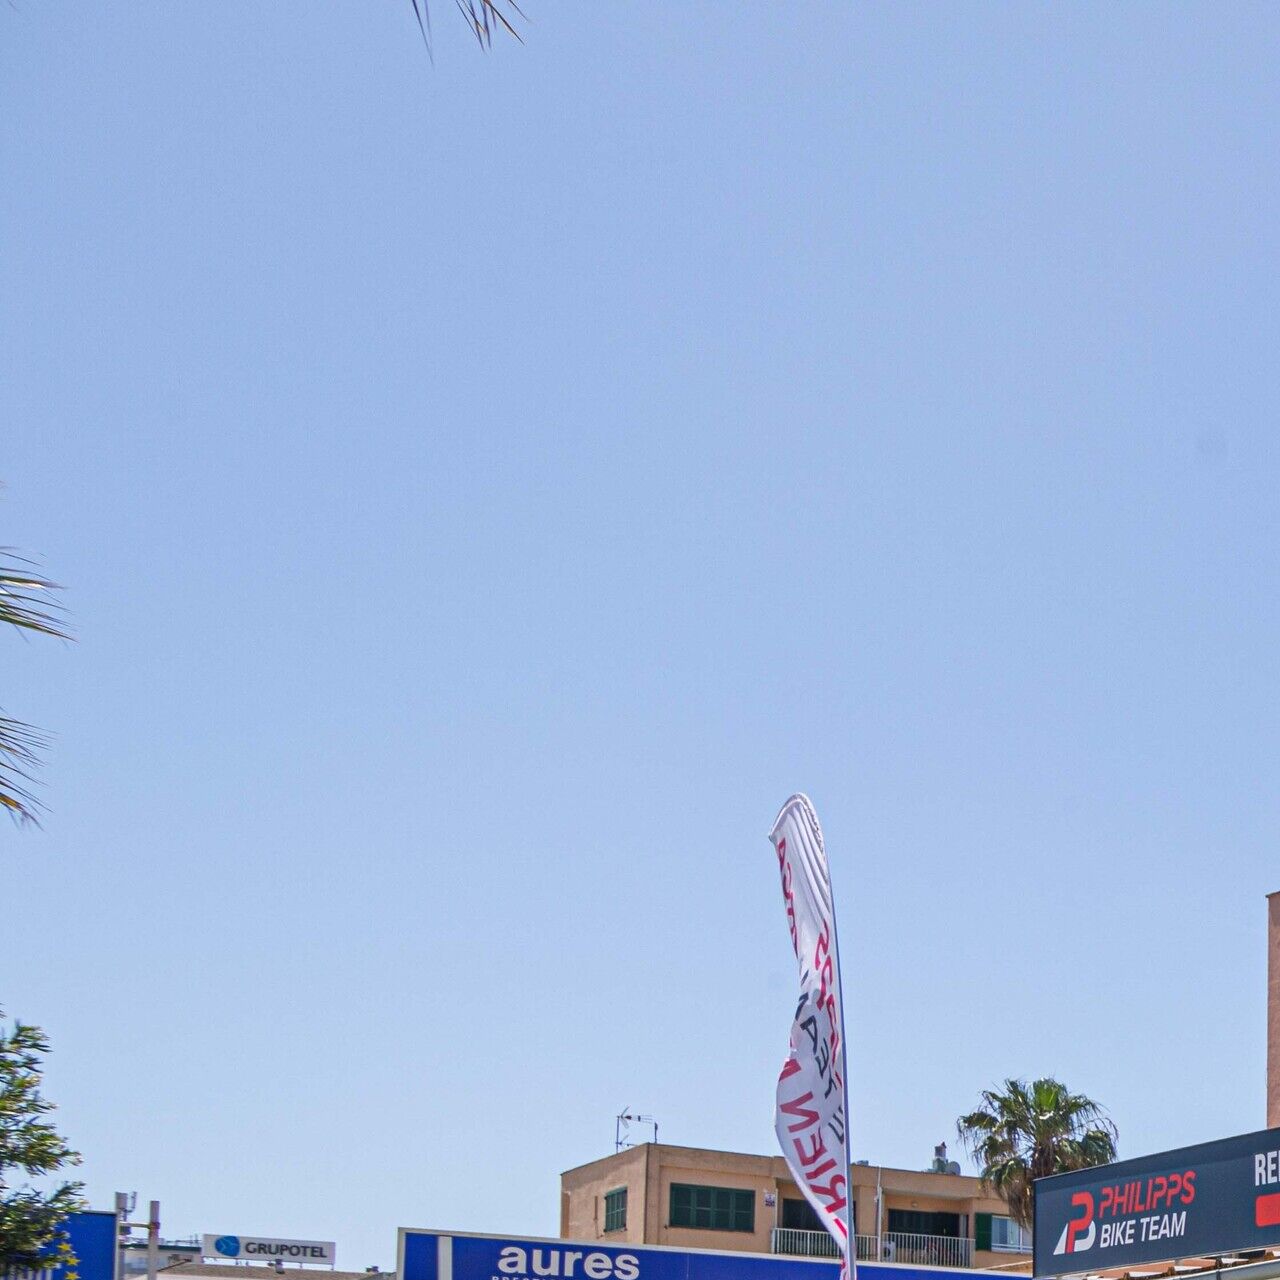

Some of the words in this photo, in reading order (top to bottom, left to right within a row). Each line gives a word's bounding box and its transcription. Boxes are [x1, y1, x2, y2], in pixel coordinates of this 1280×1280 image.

[1098, 1170, 1197, 1219] PHILIPPS
[1100, 1219, 1137, 1249] BIKE
[1140, 1210, 1187, 1242] TEAM
[245, 1241, 328, 1259] GRUPOTEL
[497, 1246, 640, 1280] aures
